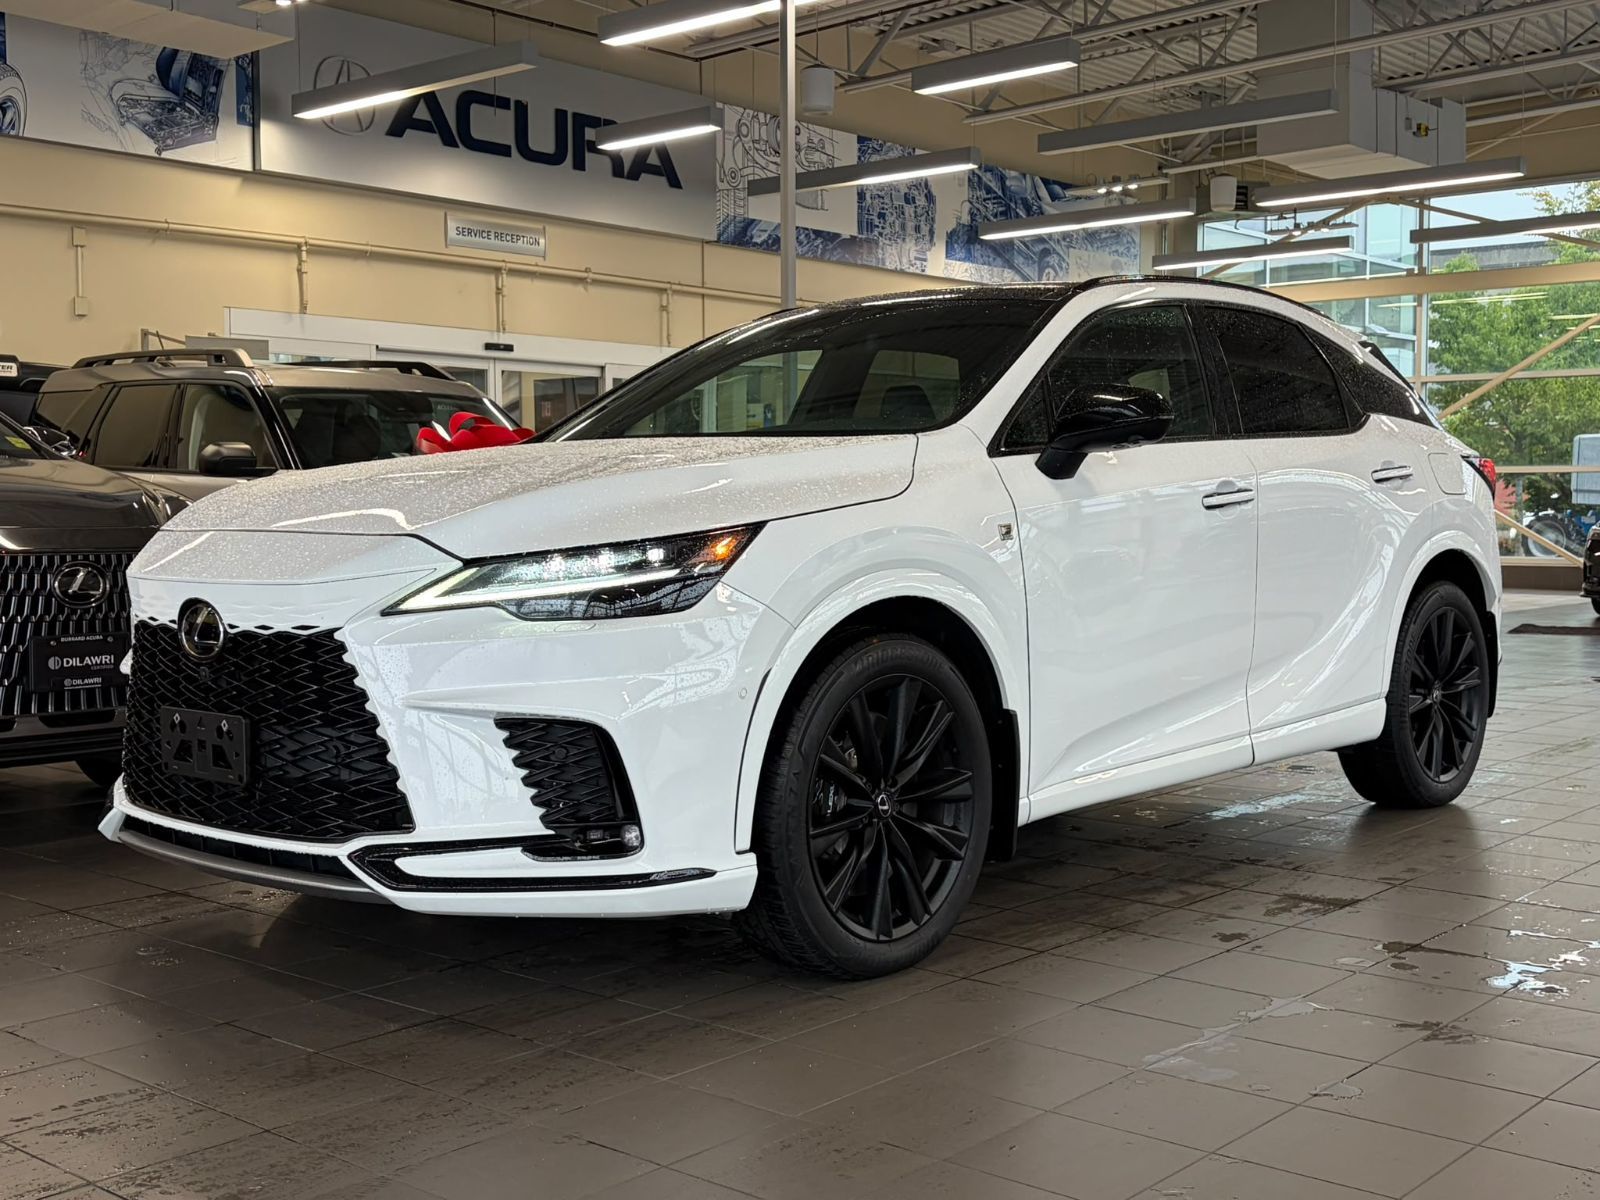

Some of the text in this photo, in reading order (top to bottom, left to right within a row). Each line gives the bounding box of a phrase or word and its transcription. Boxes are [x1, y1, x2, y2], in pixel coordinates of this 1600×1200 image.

[385, 88, 683, 190] ACURA
[455, 226, 541, 247] SERVICE RECEPTION
[63, 654, 114, 667] DILAWRI
[72, 677, 102, 685] DILAWRI
